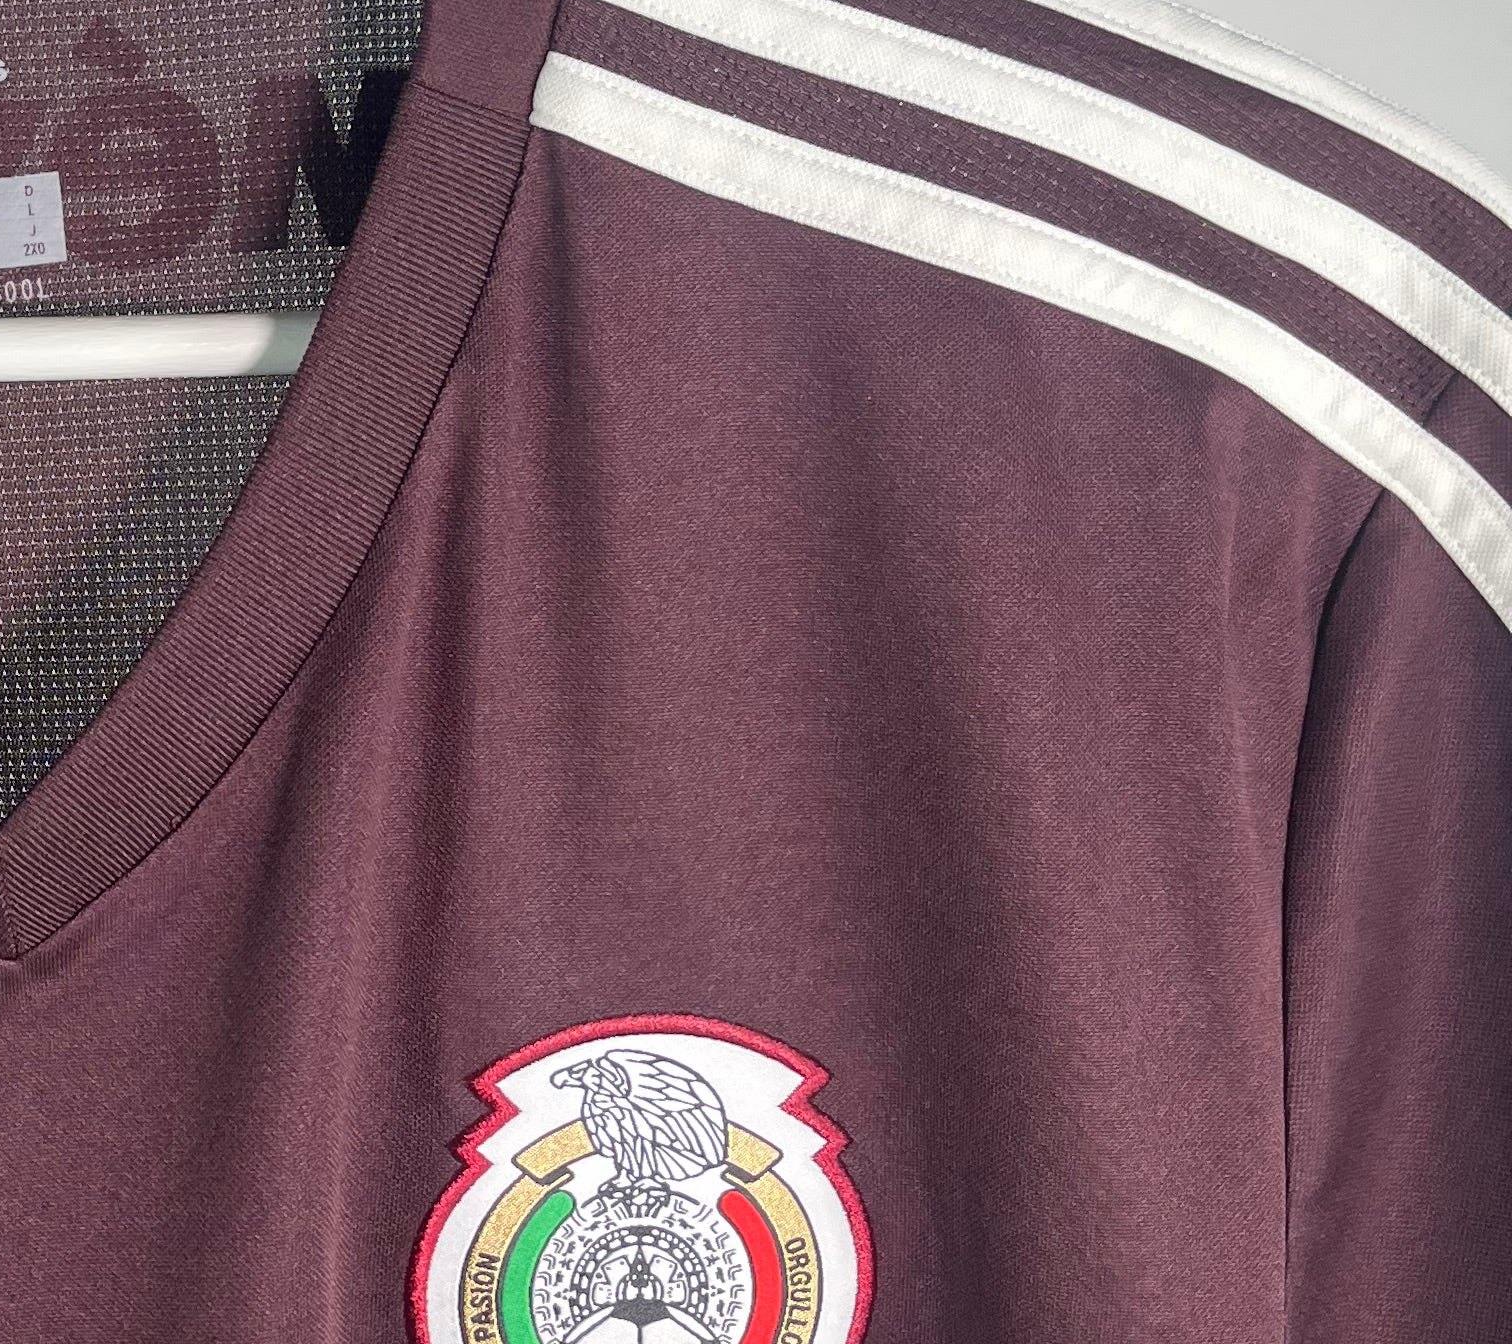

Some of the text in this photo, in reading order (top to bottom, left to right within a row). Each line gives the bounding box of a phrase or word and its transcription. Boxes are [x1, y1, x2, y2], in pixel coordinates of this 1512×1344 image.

[24, 185, 34, 197] D
[28, 203, 35, 216] L
[29, 224, 37, 237] J
[469, 1252, 501, 1343] PASIÓN
